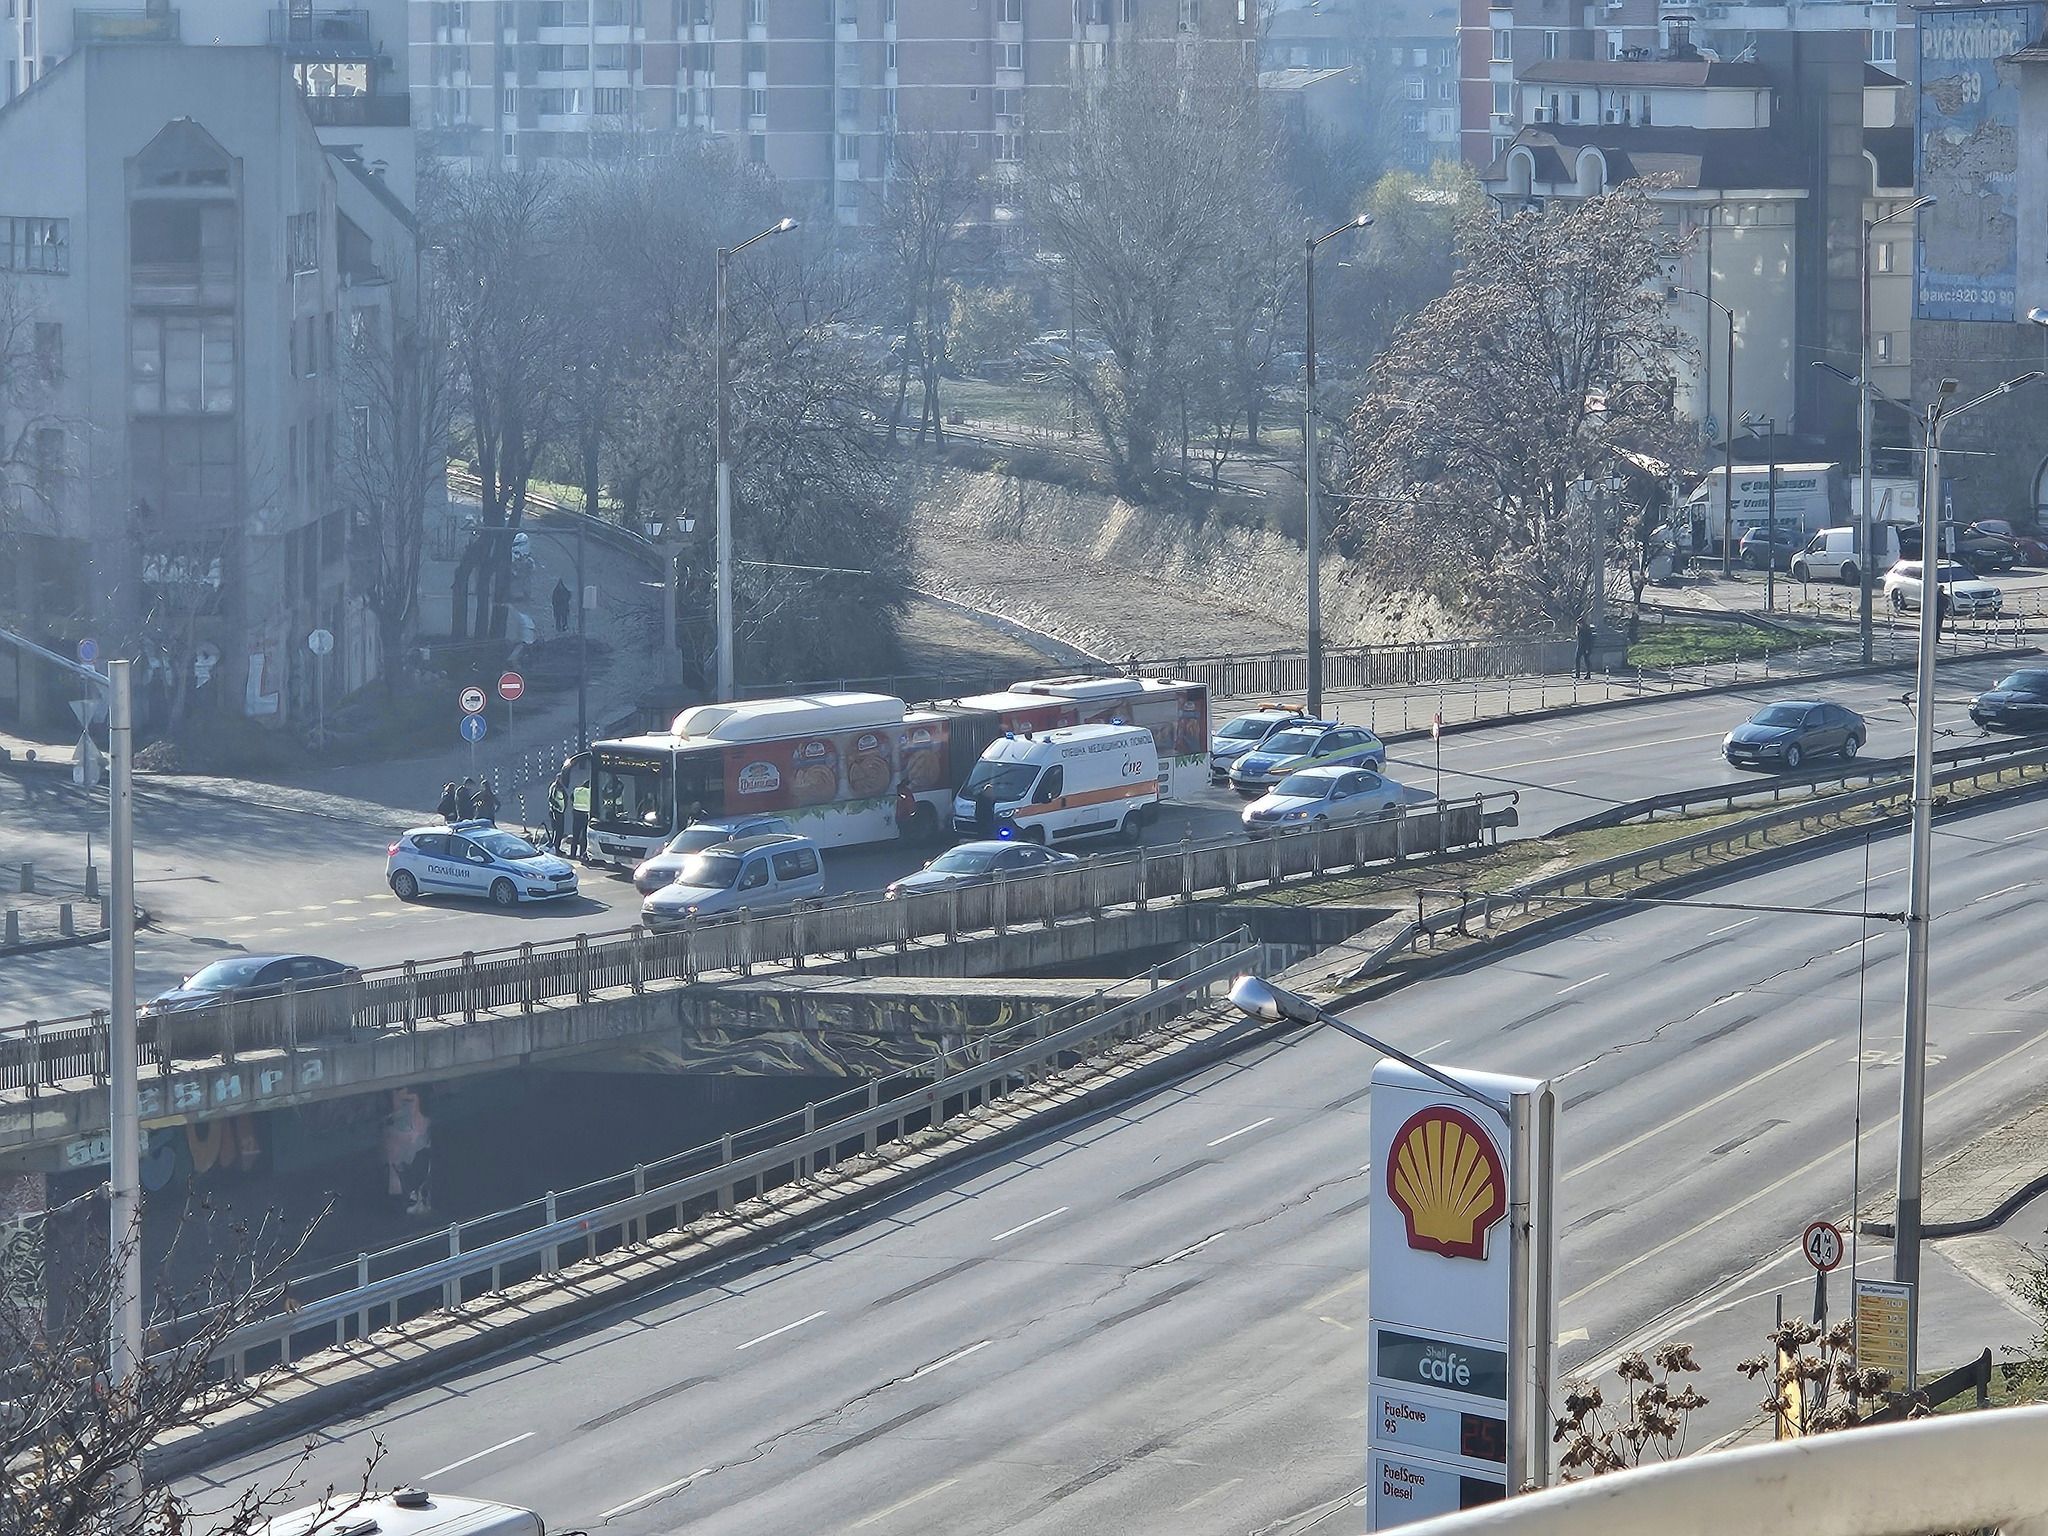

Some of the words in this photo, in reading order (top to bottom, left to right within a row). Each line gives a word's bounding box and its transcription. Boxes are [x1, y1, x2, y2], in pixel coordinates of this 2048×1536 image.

[1129, 761, 1141, 774] 112
[427, 864, 470, 878] ПОЛИЦИЯ
[1425, 1345, 1447, 1360] Shell
[1418, 1353, 1471, 1386] café
[1384, 1401, 1426, 1422] FuelSave
[1384, 1418, 1397, 1433] 95
[1383, 1464, 1425, 1485] FuelSave
[1383, 1481, 1413, 1499] Diesel
